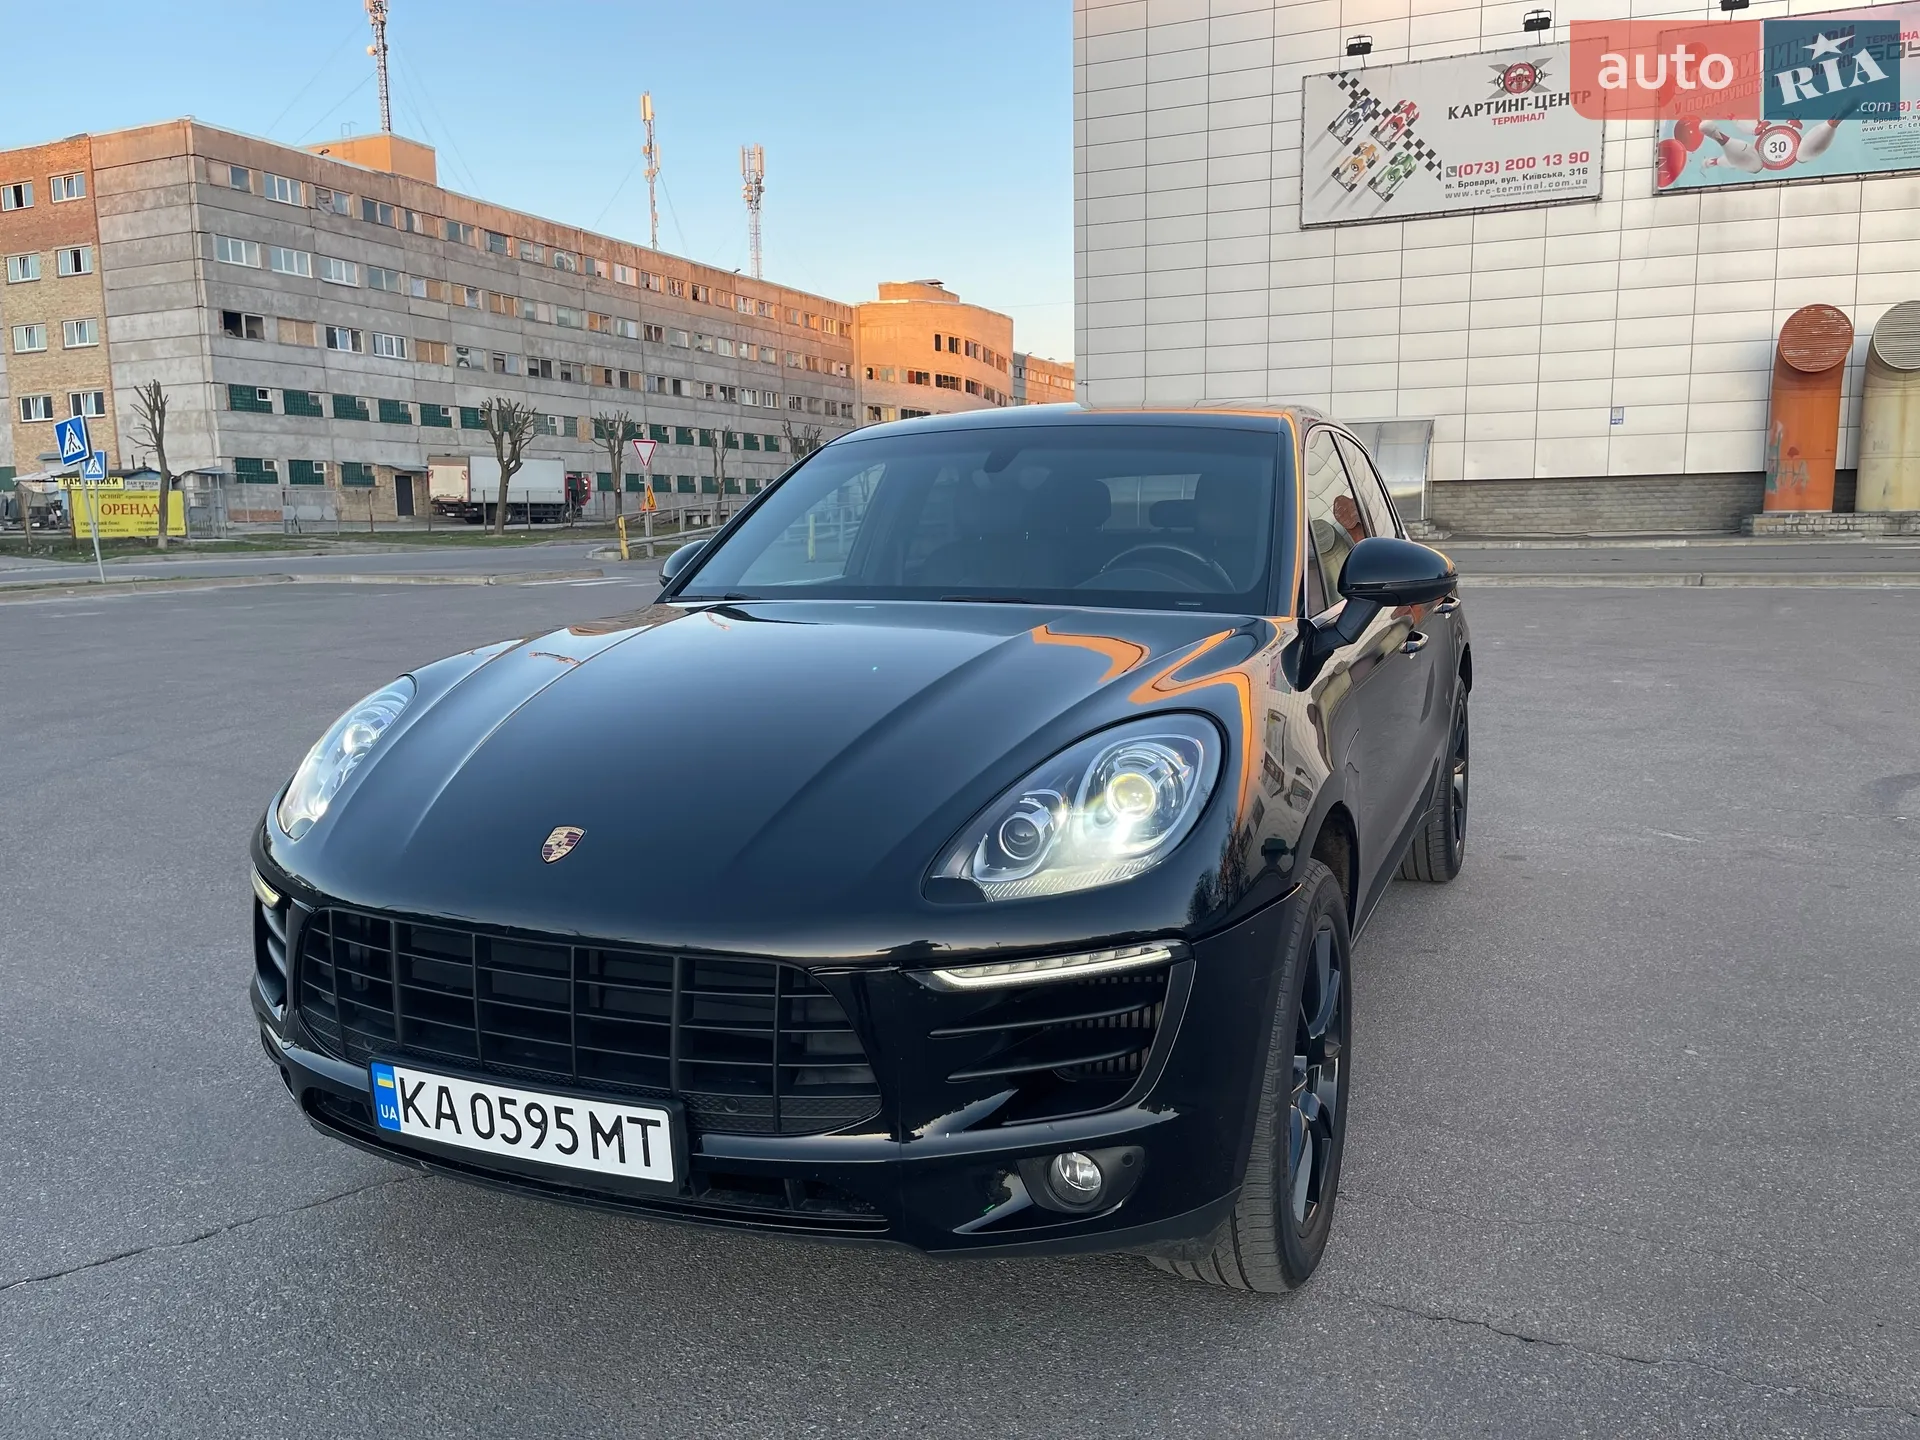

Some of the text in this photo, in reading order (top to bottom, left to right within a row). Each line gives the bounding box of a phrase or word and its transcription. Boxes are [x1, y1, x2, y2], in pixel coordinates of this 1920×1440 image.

[1448, 90, 1592, 120] КАРТИНГ-ЦЕНТР
[1492, 112, 1546, 126] ТЕРМІНАЛ
[1769, 141, 1787, 153] 30
[1458, 151, 1590, 178] (073) 200 13 90
[1445, 178, 1588, 199] www.trc-terminal.com.ua
[1457, 179, 1499, 190] Бровари,
[1501, 176, 1519, 185] вул.
[1522, 171, 1566, 182] Київська,
[101, 503, 160, 518] ОРЕНДА
[381, 1103, 398, 1121] UA
